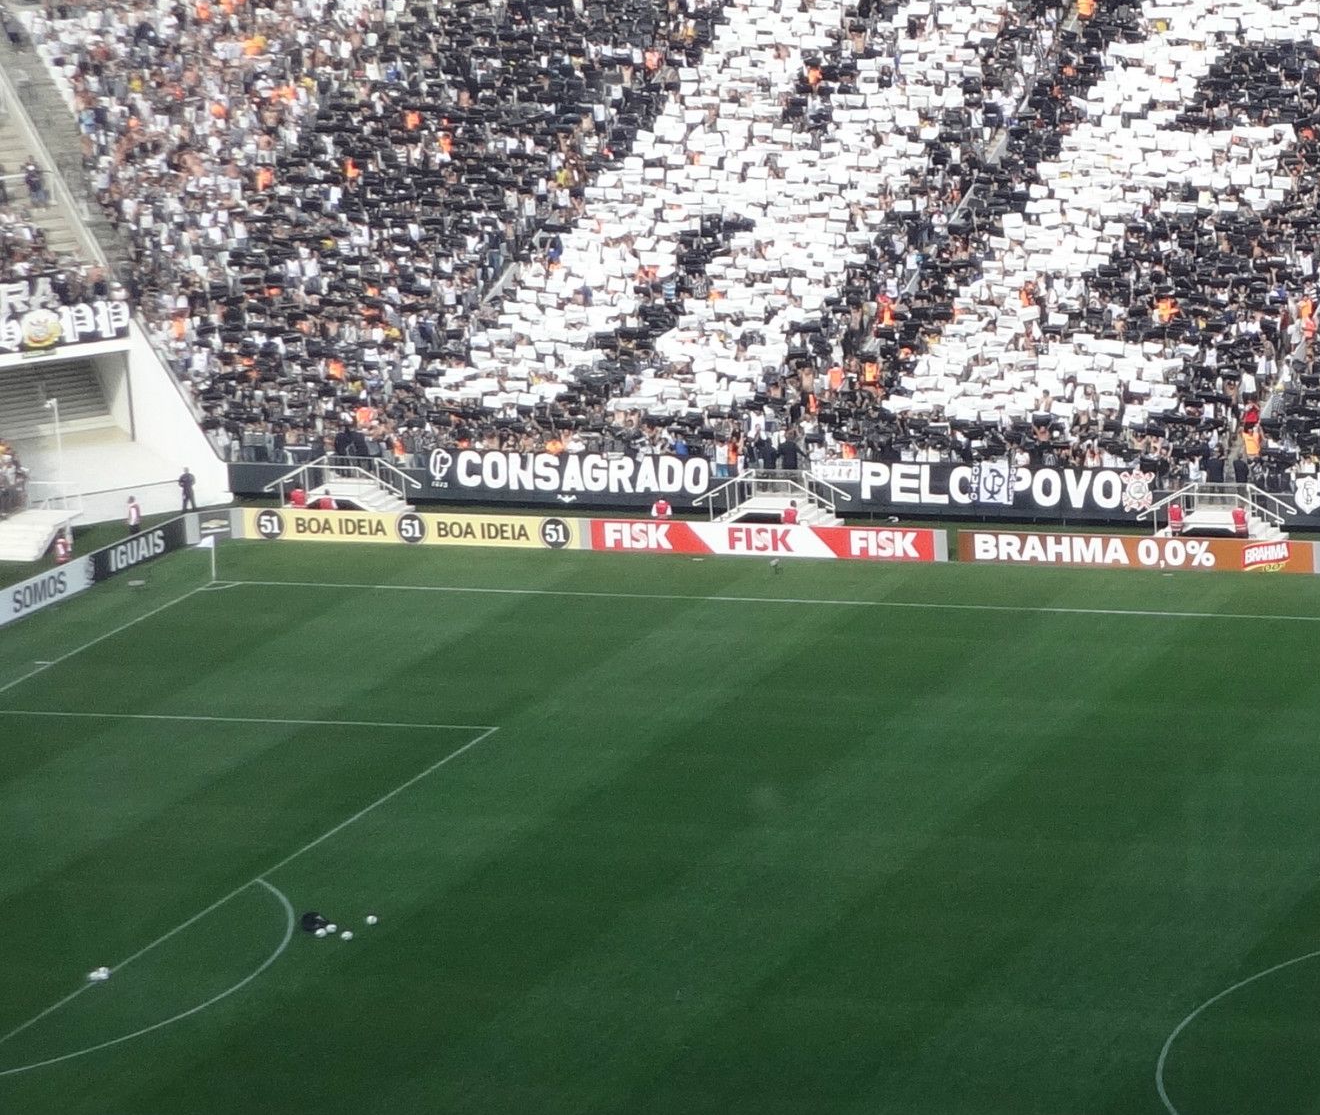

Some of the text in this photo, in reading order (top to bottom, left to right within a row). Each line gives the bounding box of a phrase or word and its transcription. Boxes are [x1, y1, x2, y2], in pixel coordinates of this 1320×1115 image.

[457, 451, 710, 494] CONSAGRADO
[260, 516, 566, 543] 51 BOA IDEIA 51 BOA IDEIA 51
[604, 523, 918, 557] FISK FISK FISK
[110, 530, 165, 572] IGUAIS
[974, 534, 1129, 565] BRAHMA
[1138, 539, 1215, 568] 0,0%
[13, 571, 67, 613] SOMOS
